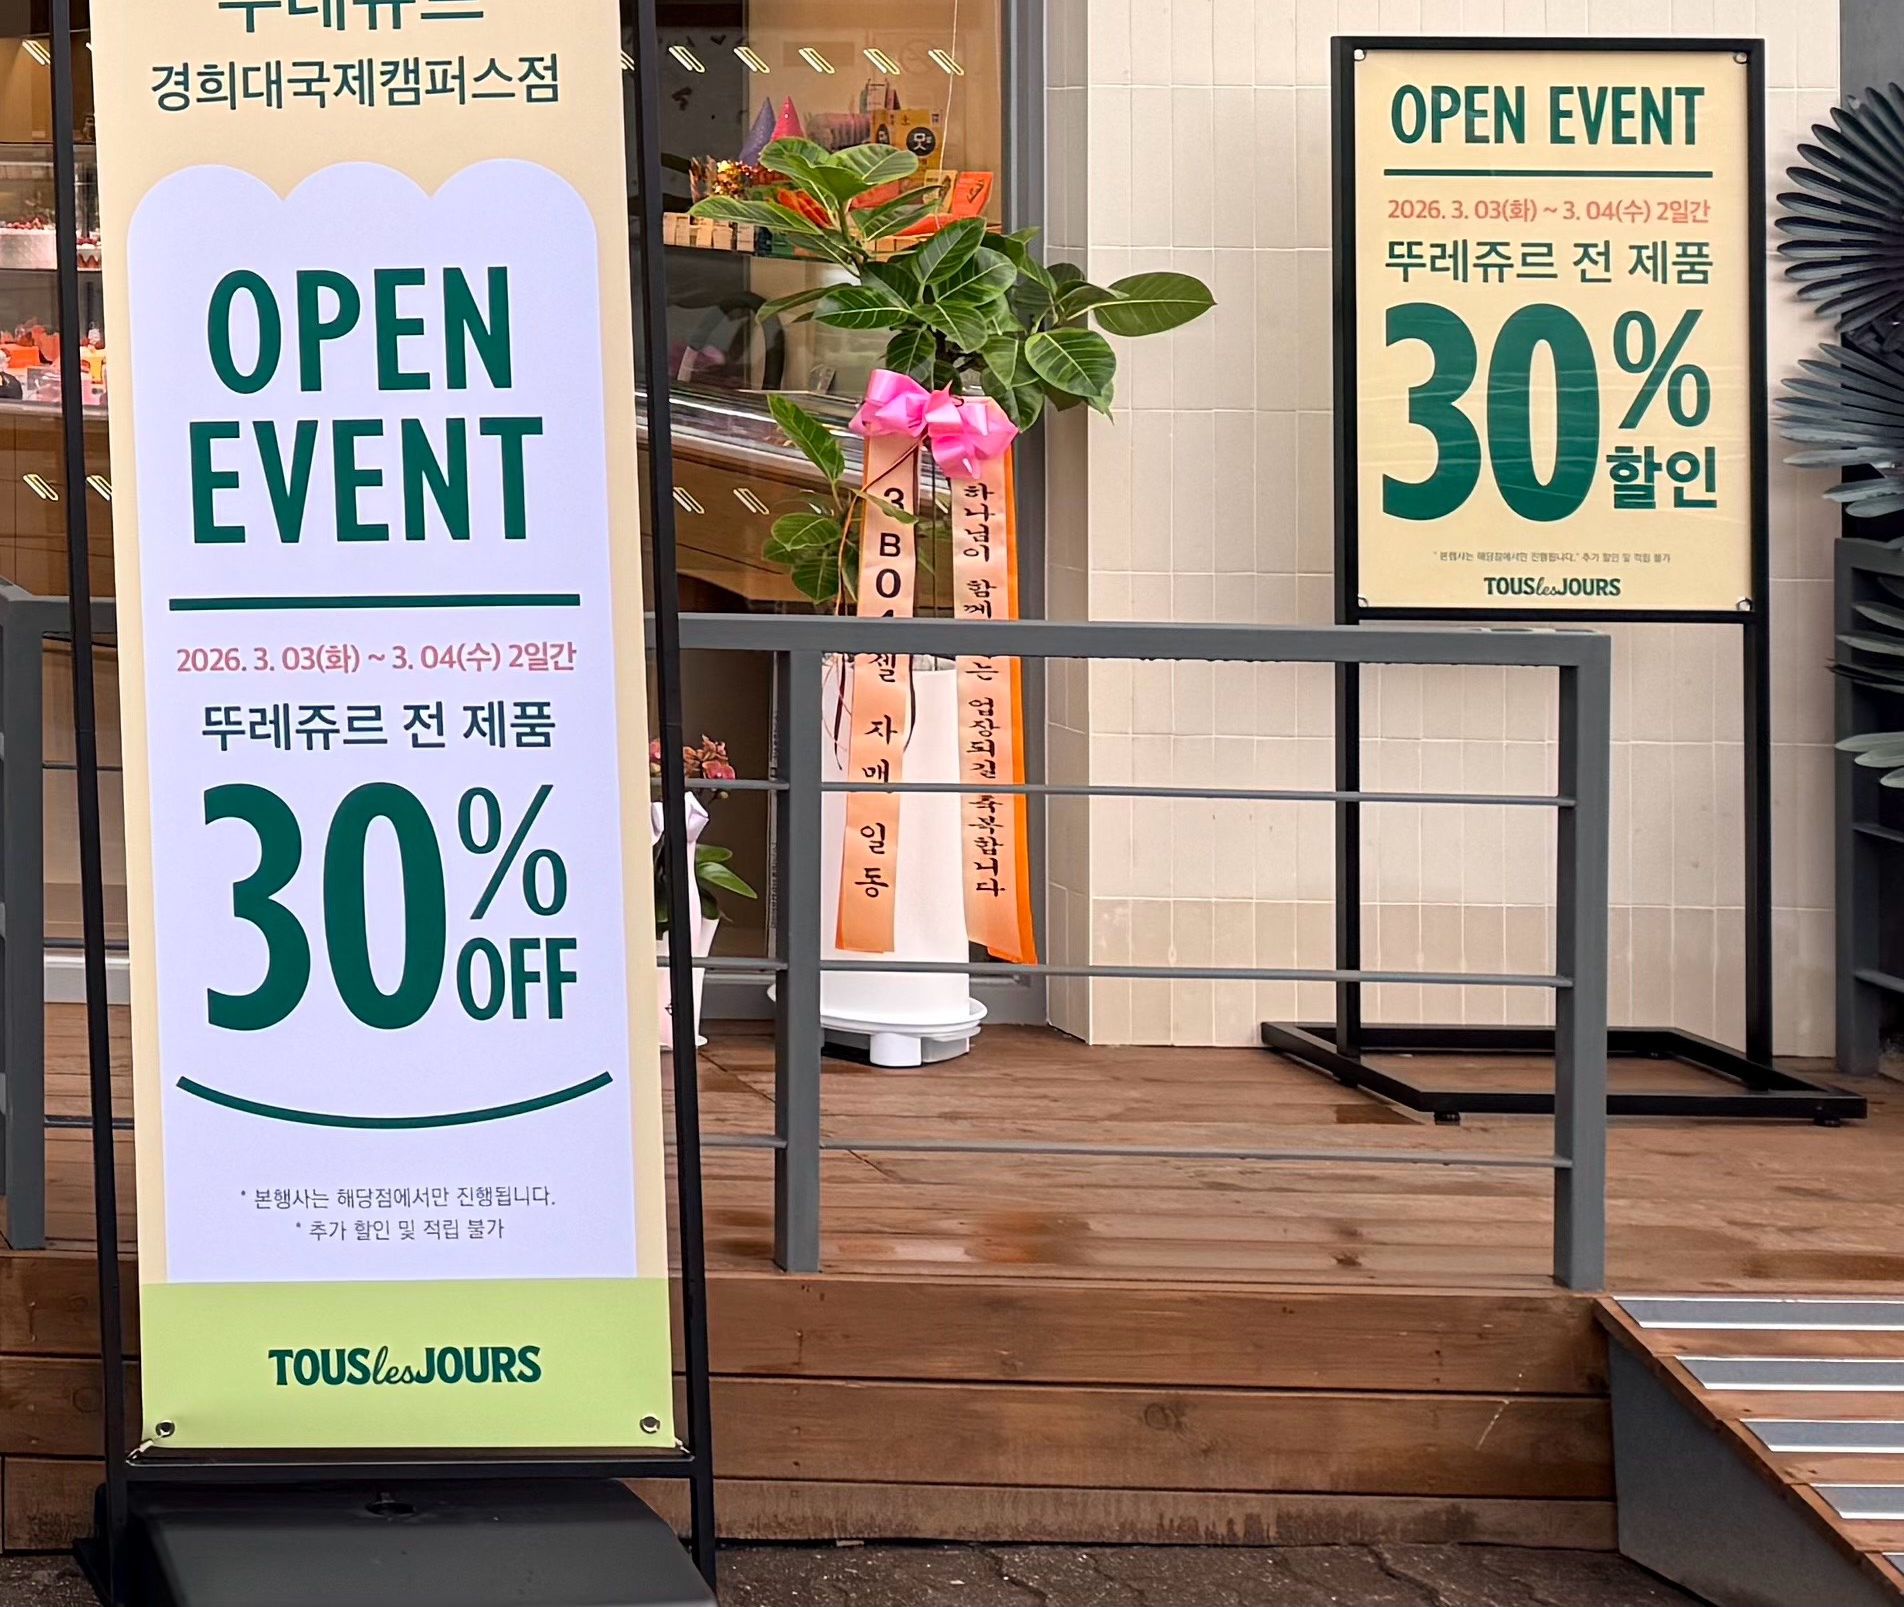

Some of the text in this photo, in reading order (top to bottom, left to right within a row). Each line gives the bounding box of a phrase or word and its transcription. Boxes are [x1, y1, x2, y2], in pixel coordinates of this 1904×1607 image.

[150, 53, 561, 112] 경희대국제캠퍼스점
[1391, 84, 1706, 147] OPEN EVENT
[1387, 198, 1447, 221] 2026.
[1451, 199, 1470, 221] 3.
[1473, 199, 1538, 224] 03(화)
[1562, 201, 1582, 222] 3.
[1586, 200, 1652, 225] 04(수)
[1656, 200, 1712, 225] 2일간
[1385, 240, 1715, 285] 뚜레쥬르 전 제품
[207, 266, 513, 394] OPEN
[189, 416, 543, 544] EVENT
[1606, 446, 1719, 510] 할인
[963, 482, 996, 563] 하나님이
[176, 647, 247, 673] 2026.
[253, 646, 276, 672] 3.
[282, 643, 361, 675] 03(화)
[391, 645, 414, 671] 3.
[420, 642, 502, 673] 04(수)
[508, 641, 578, 672] 2일간
[964, 578, 1000, 682] 함께는
[201, 700, 556, 752] 뚜레쥬르 전 제품
[861, 714, 899, 784] 자매
[854, 822, 890, 899] 일동
[455, 937, 579, 1021] OFF
[254, 1185, 556, 1210] 본행사는 해당점에서만 진행됩니다.
[309, 1218, 505, 1242] 추가 할인 및 적립 불가
